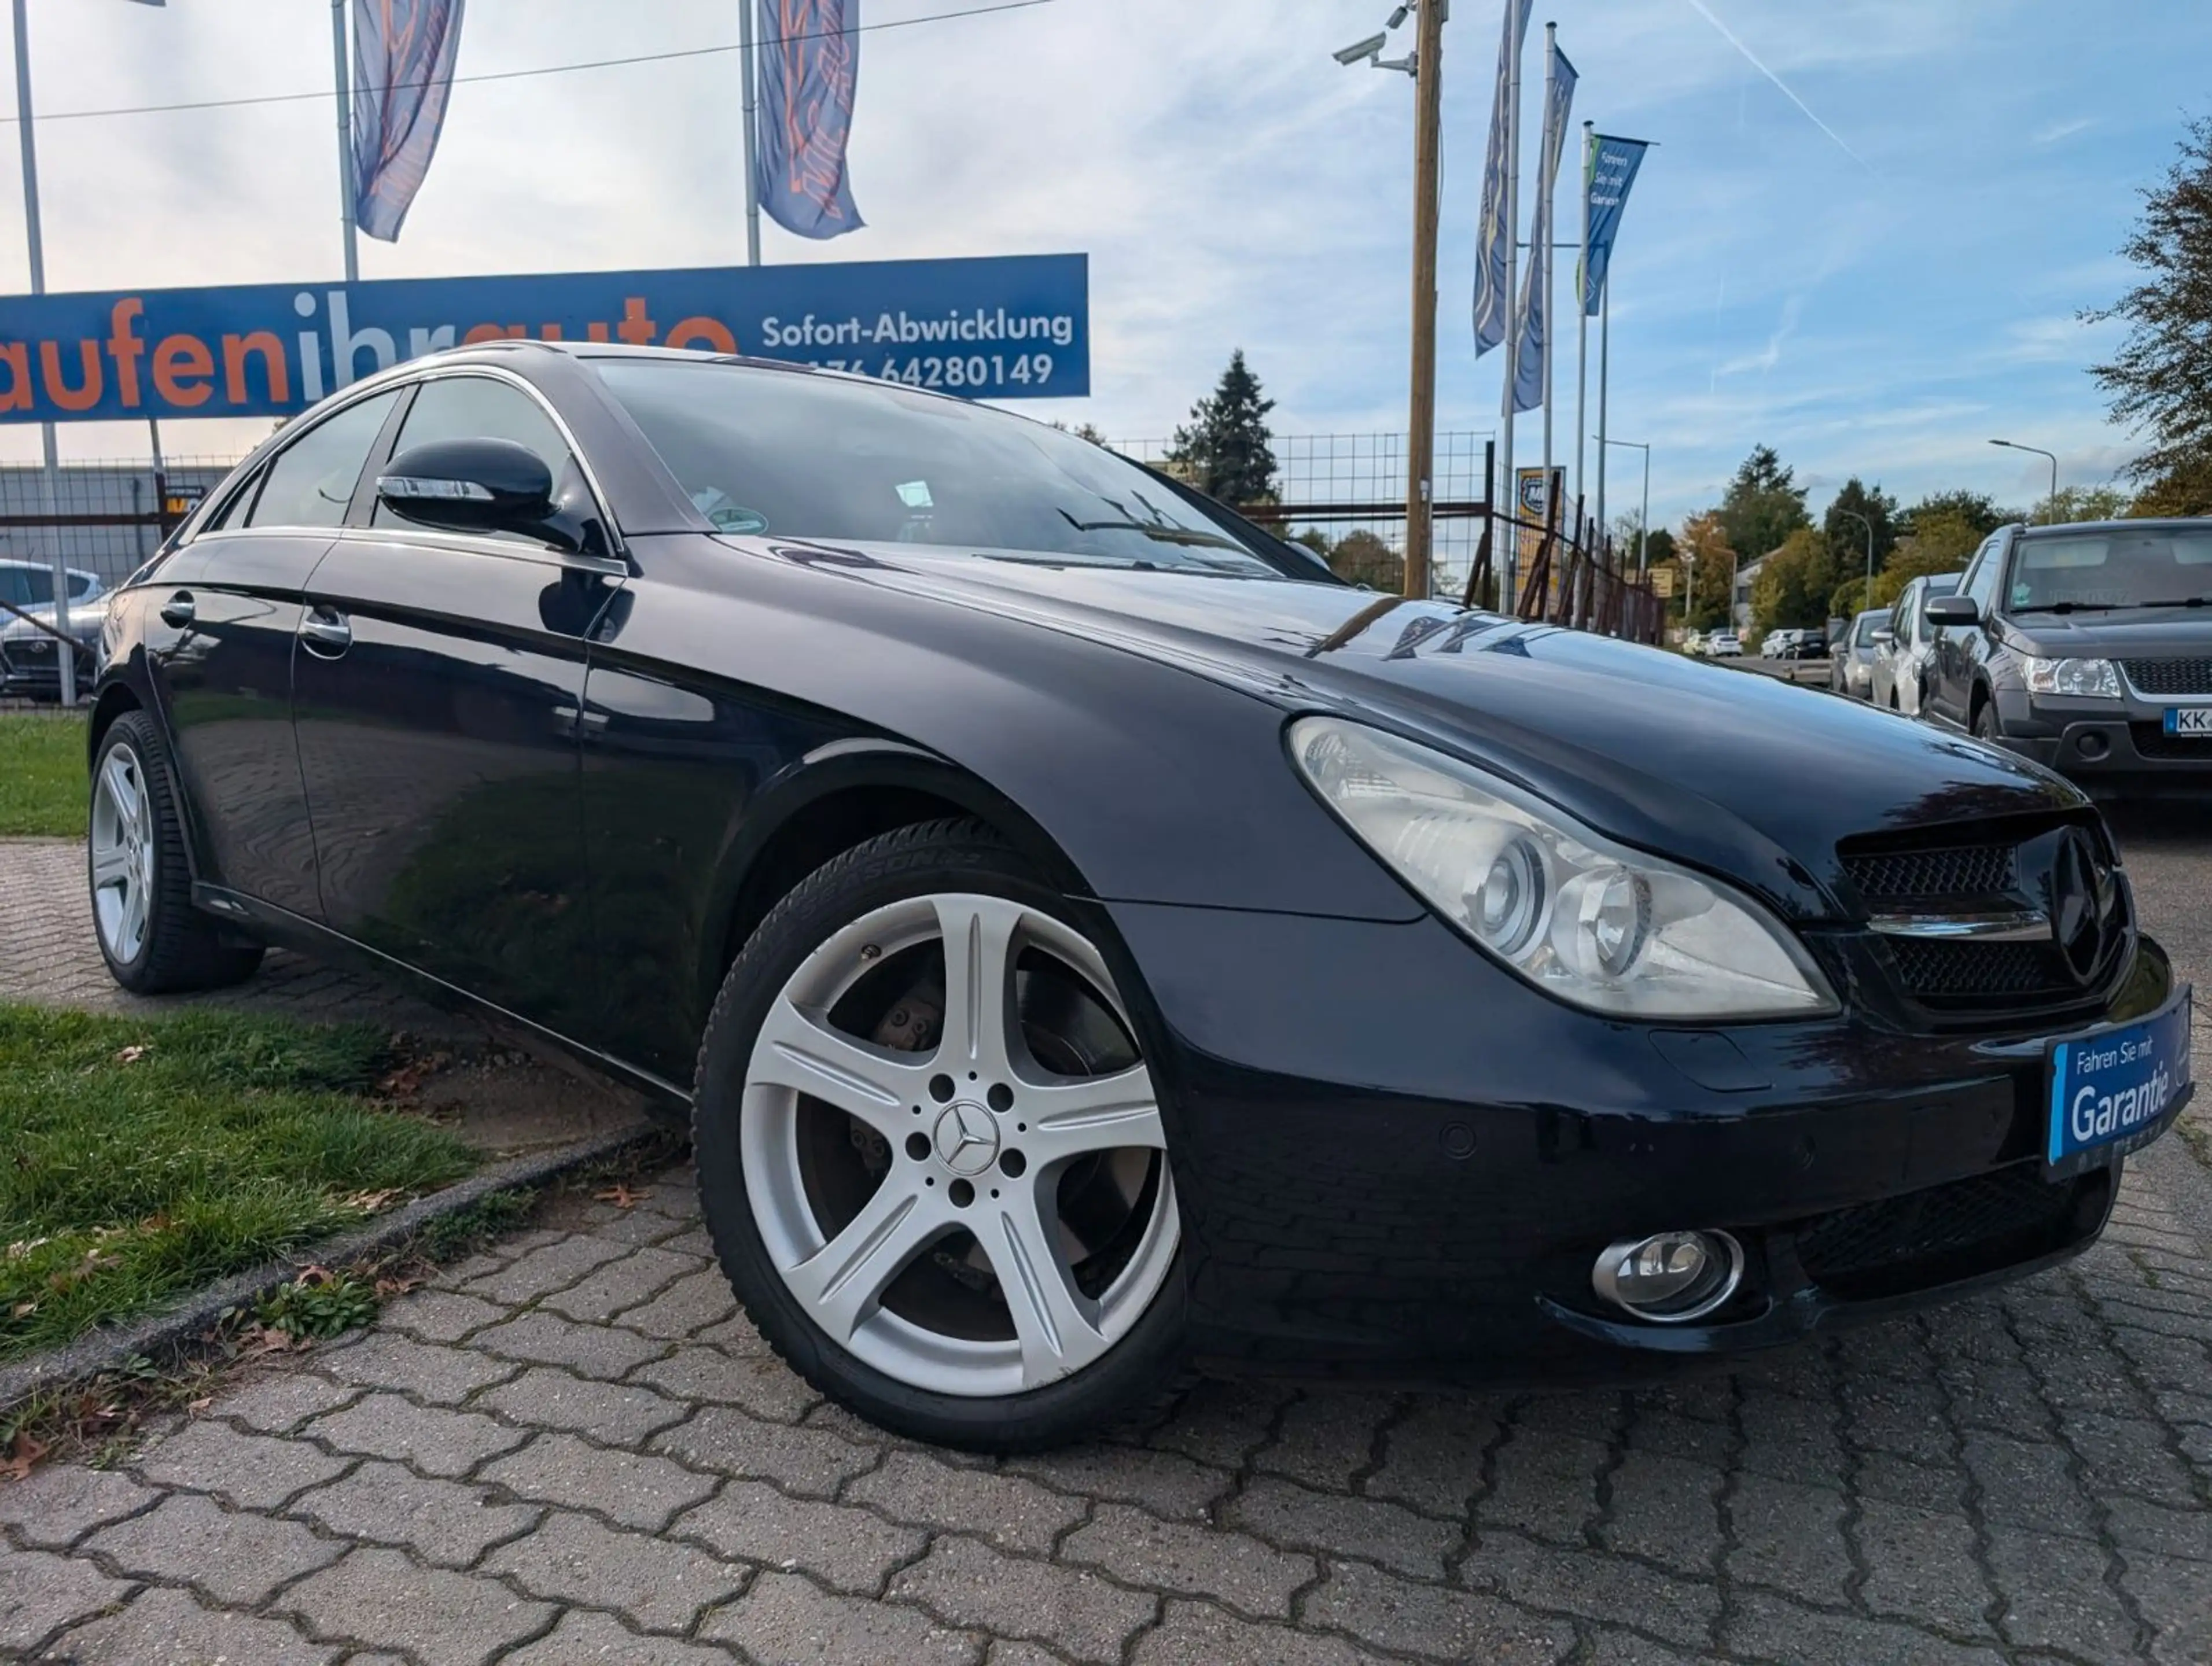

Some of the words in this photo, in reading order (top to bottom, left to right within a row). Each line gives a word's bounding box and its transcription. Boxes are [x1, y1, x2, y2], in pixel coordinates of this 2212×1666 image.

[763, 309, 1073, 347] Sofort-Abwicklung
[880, 353, 1054, 387] 64280149
[2077, 1048, 2118, 1075] Fahren
[2120, 1041, 2136, 1064] Sie
[2137, 1035, 2154, 1058] mit
[2071, 1060, 2169, 1142] Garantie
